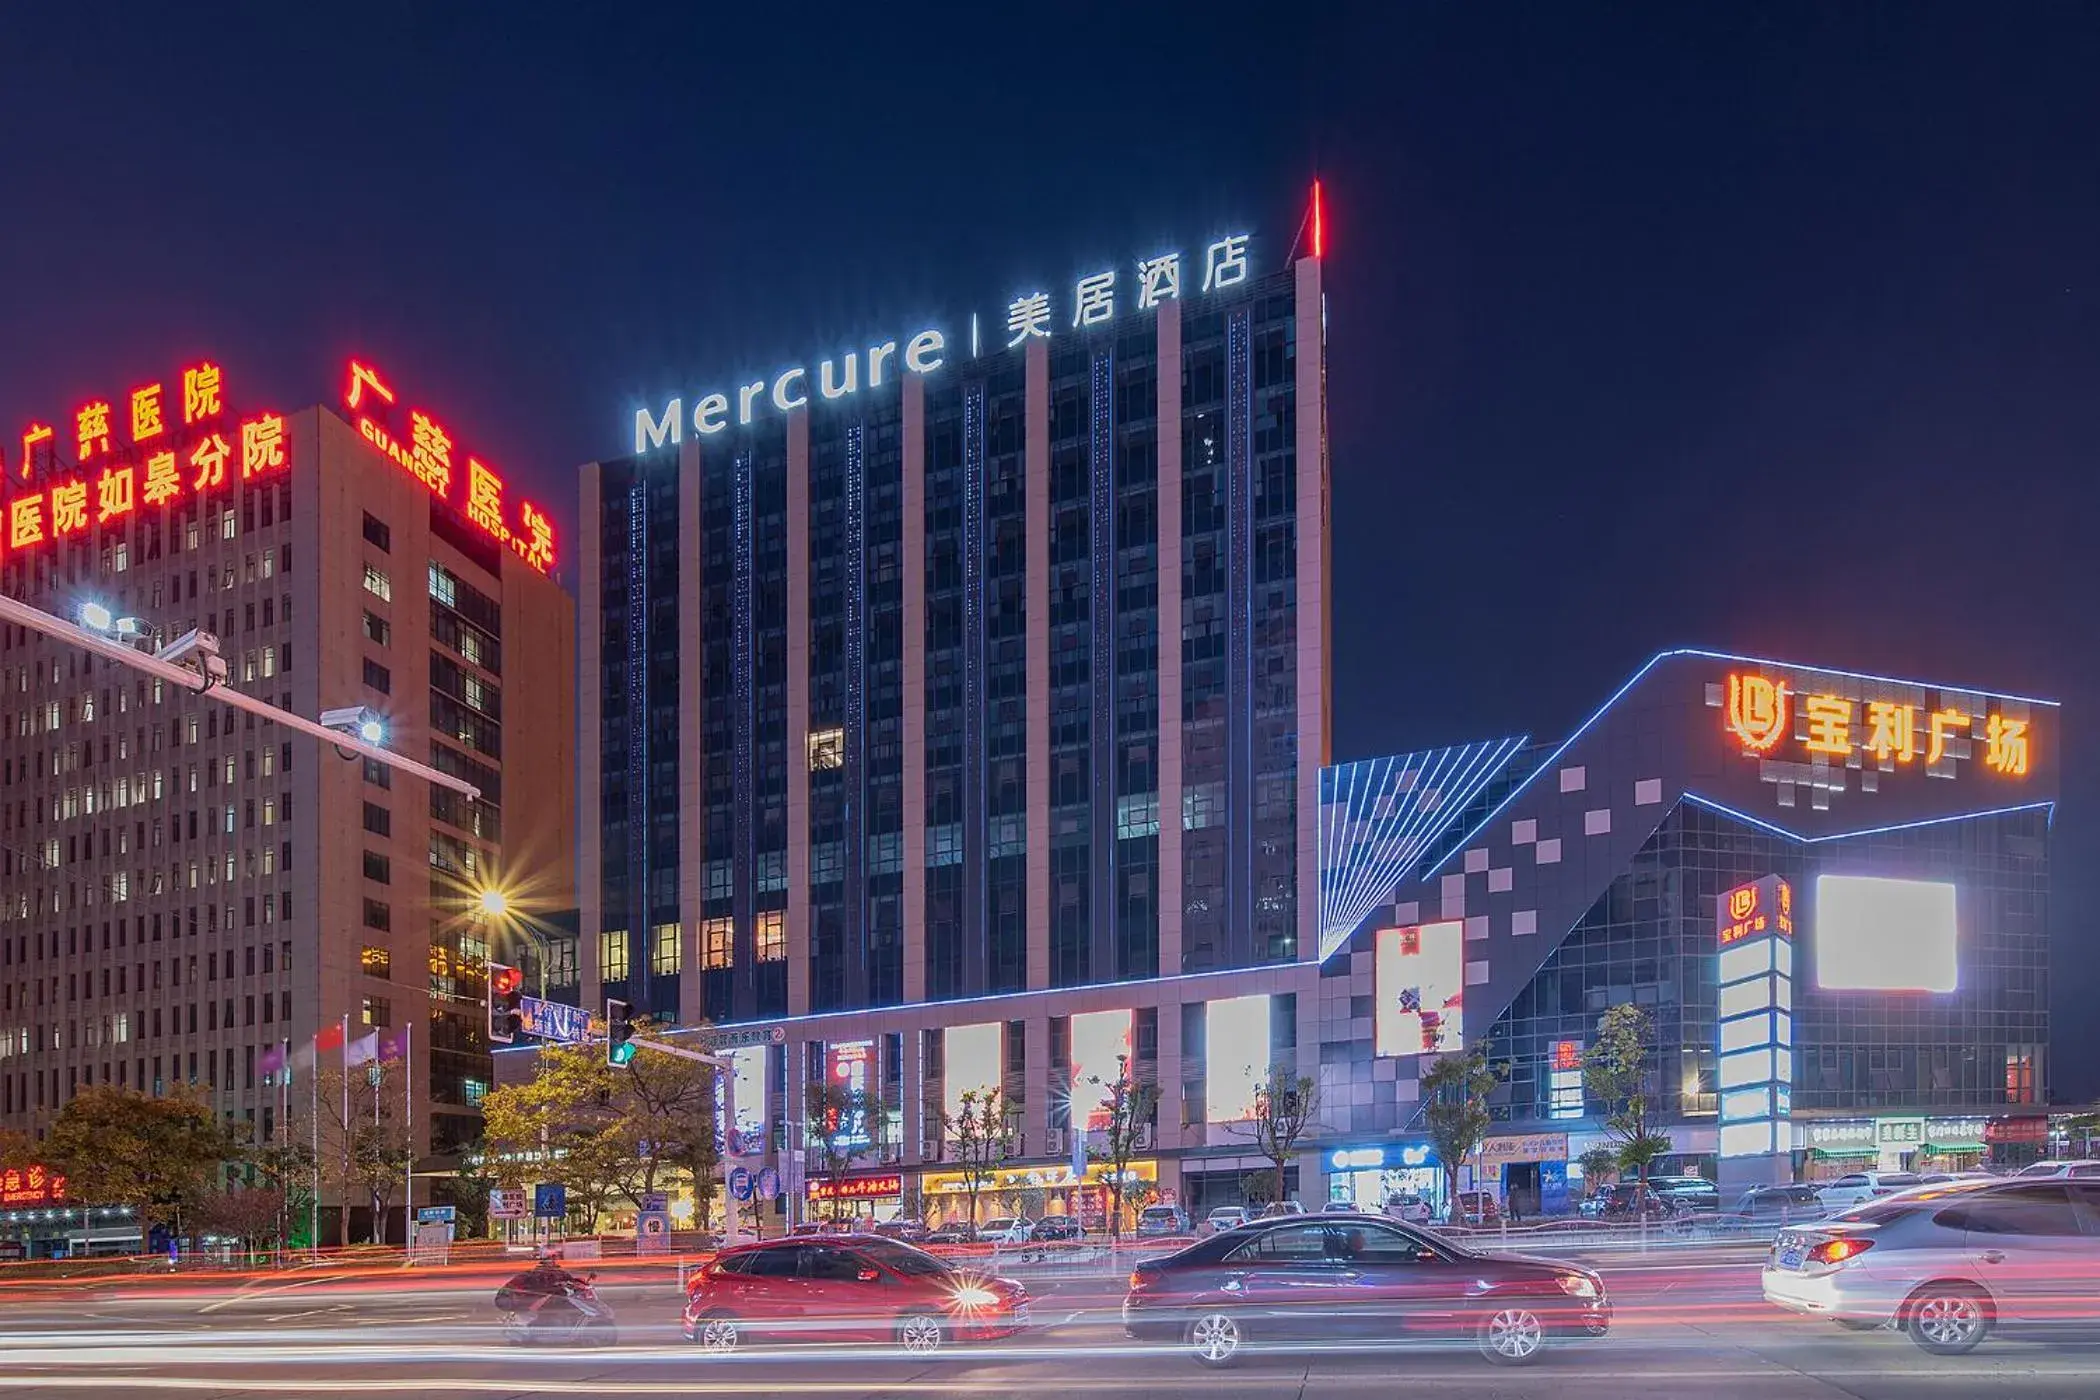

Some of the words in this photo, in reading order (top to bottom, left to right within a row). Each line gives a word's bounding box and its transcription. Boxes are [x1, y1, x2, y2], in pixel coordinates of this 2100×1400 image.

[1008, 234, 1250, 348] 美居酒店
[634, 327, 945, 453] Mercure
[0, 413, 284, 548] 医院如皋分院
[348, 360, 553, 563] 广慈医院
[360, 416, 448, 498] GUANGCI
[467, 500, 547, 574] HOSPITAL
[1806, 695, 2028, 774] 宝利广场
